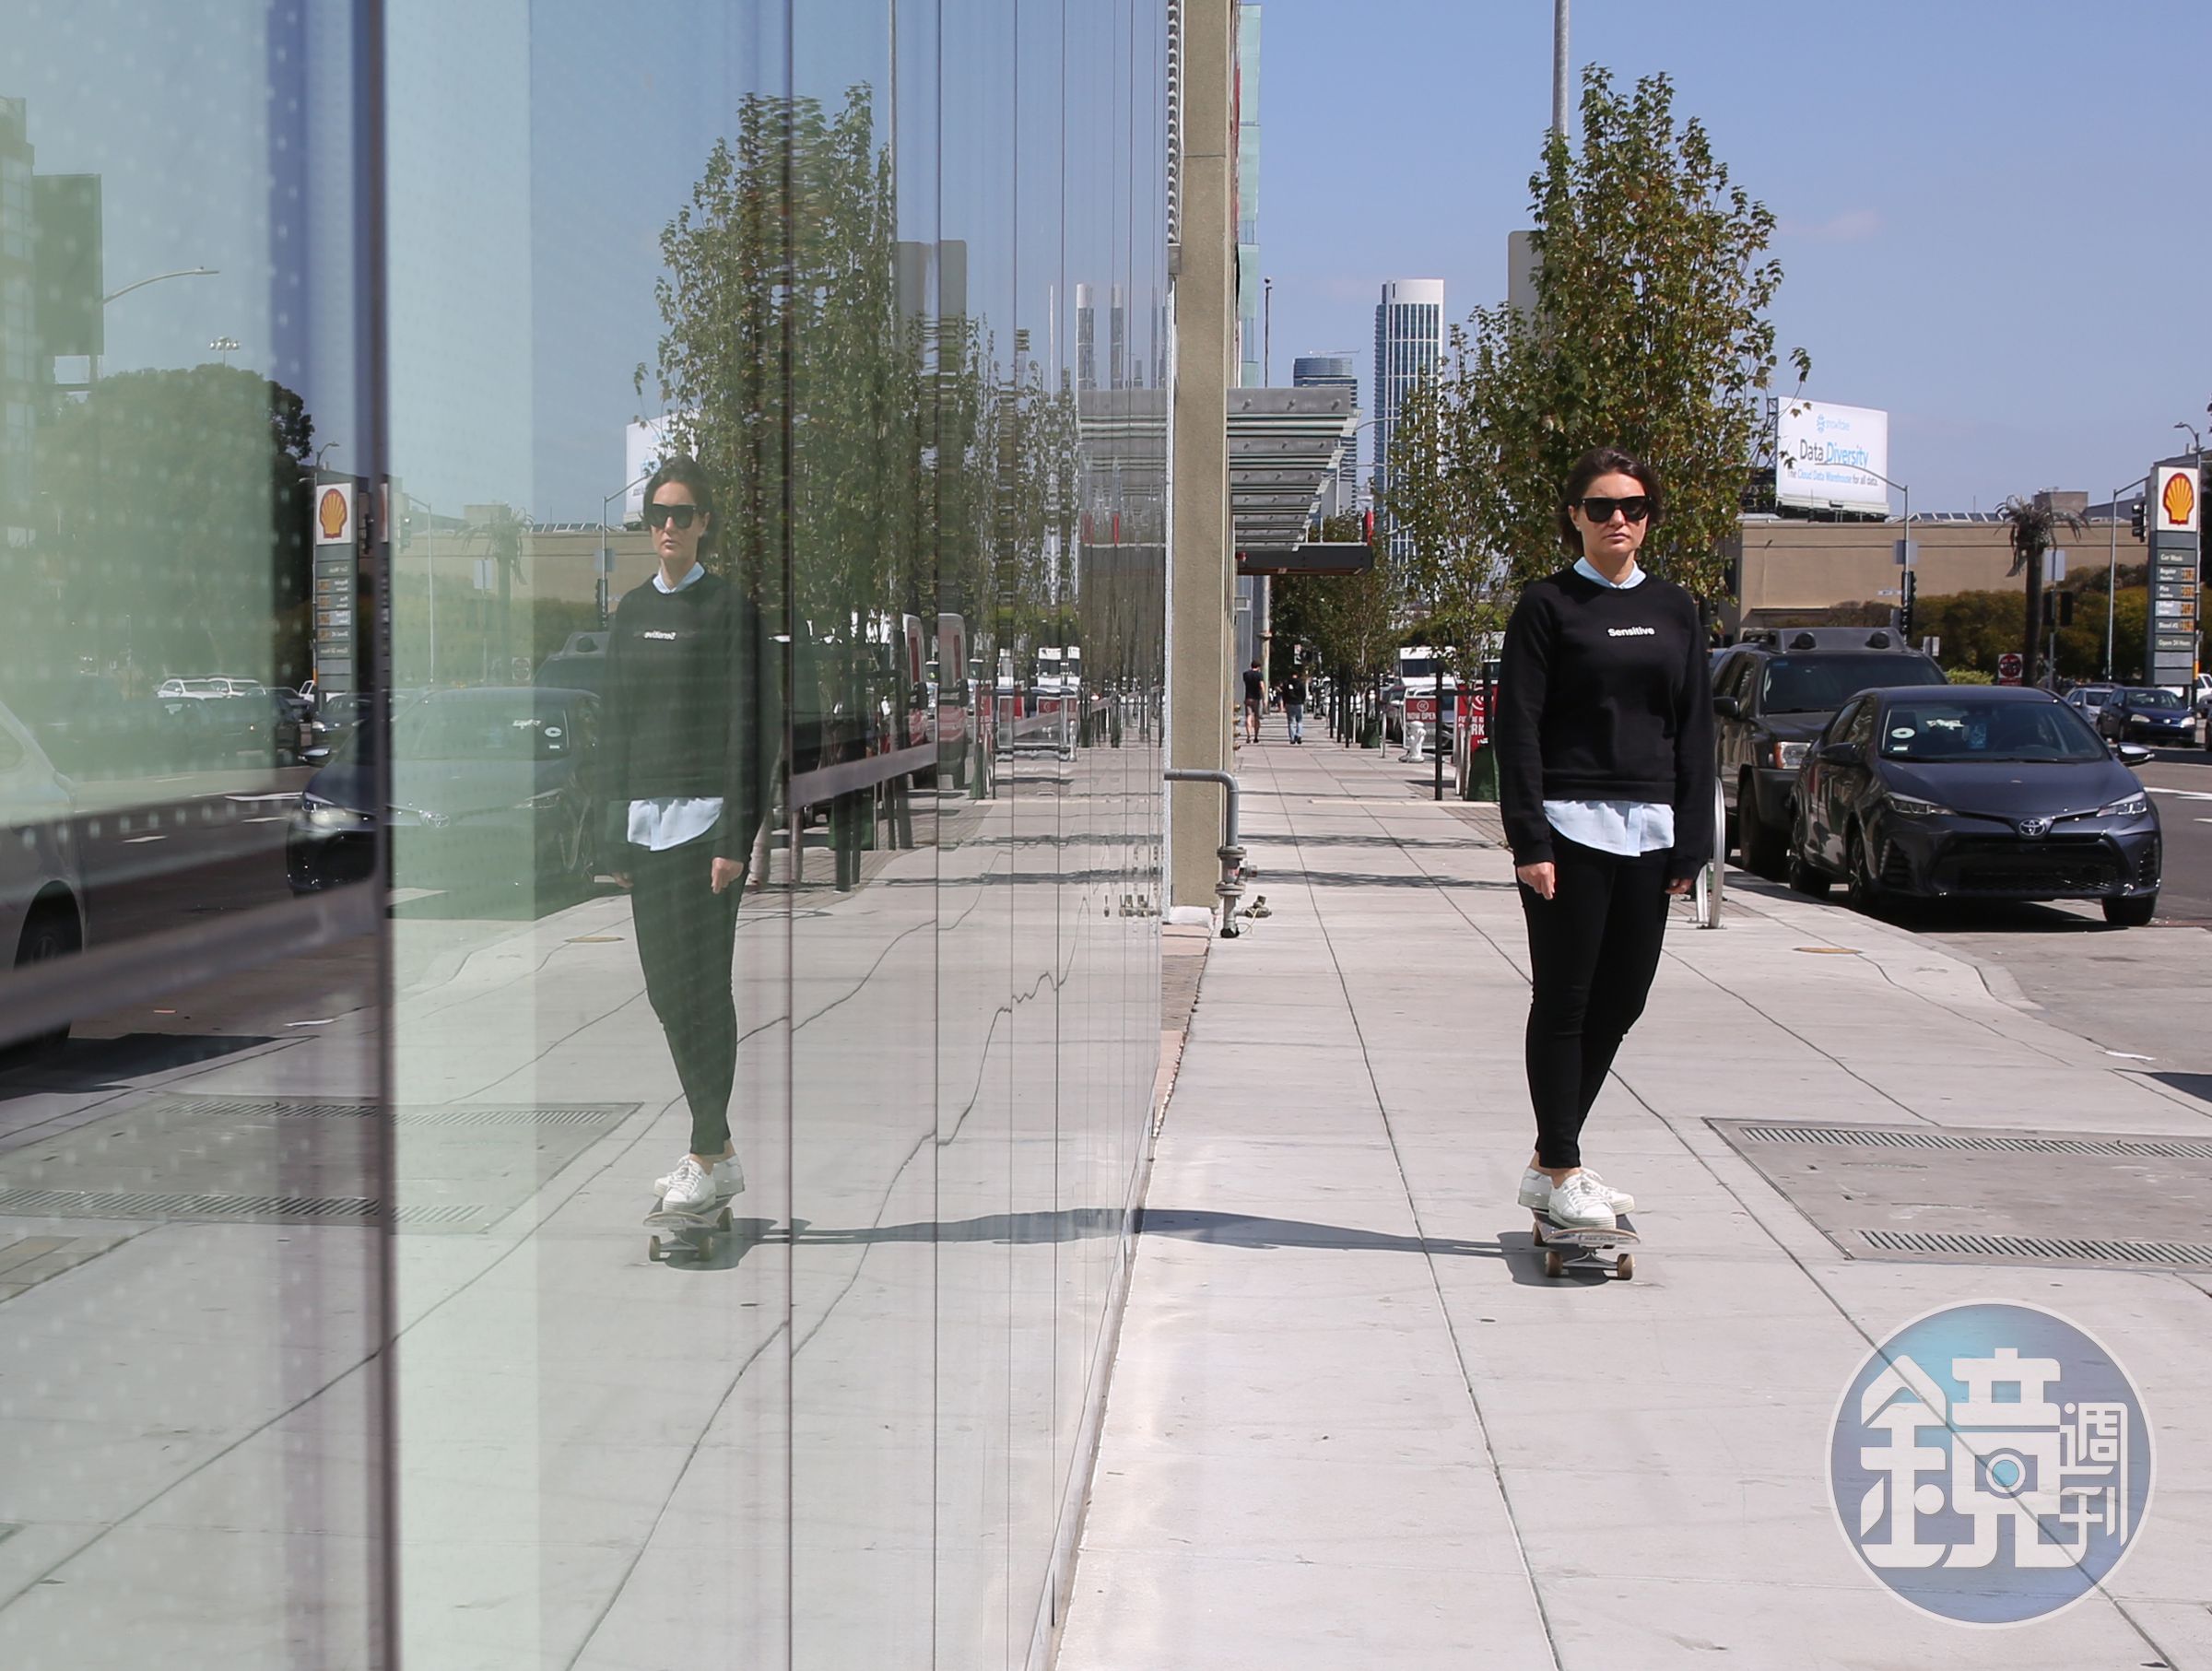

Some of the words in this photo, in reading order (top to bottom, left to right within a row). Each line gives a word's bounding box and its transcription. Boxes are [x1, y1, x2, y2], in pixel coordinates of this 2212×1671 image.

[1800, 439, 1824, 462] Data
[1827, 441, 1869, 469] Diversity
[1607, 626, 1655, 637] Sensitive
[1406, 712, 1420, 720] NOW
